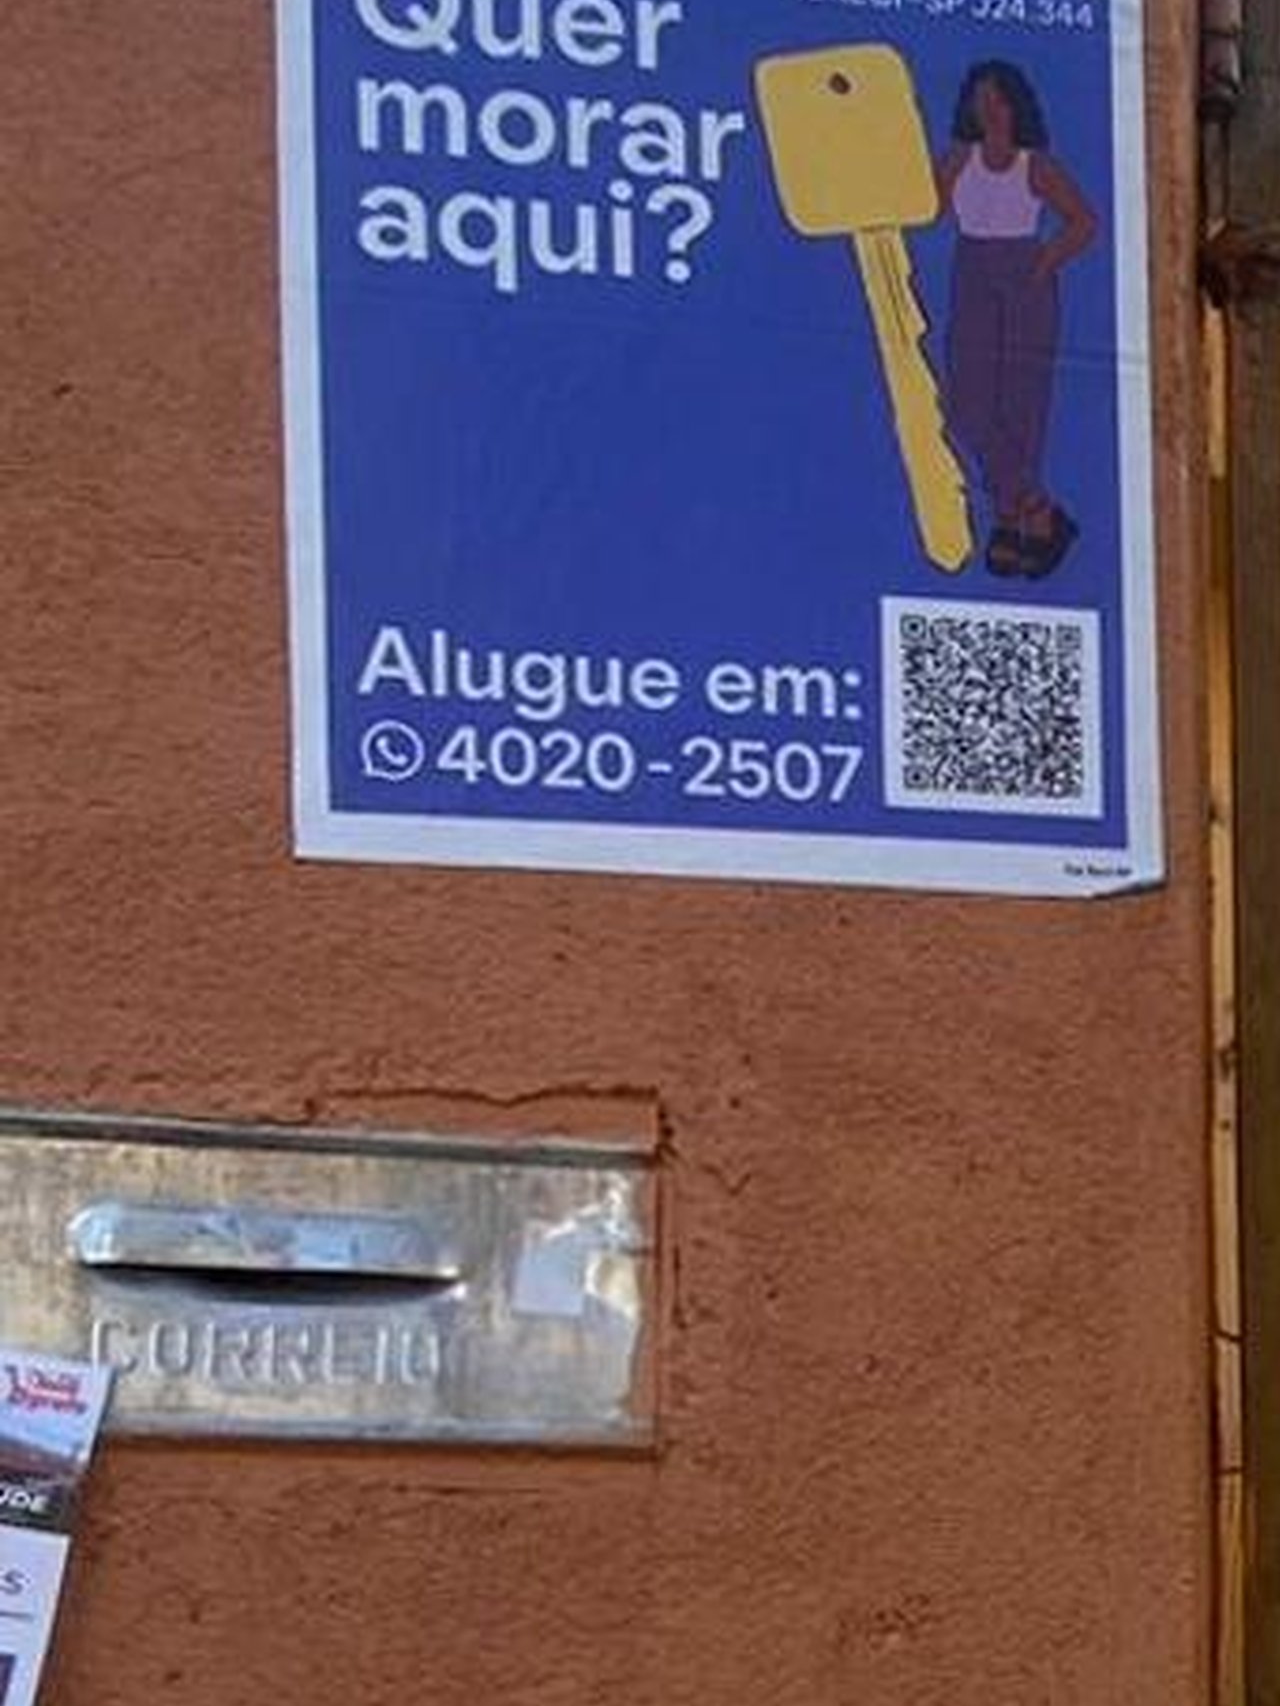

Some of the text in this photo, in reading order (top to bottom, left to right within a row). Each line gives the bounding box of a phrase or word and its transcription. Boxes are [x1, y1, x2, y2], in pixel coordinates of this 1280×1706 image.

[358, 72, 743, 180] morar
[358, 181, 713, 293] aqui?
[359, 627, 863, 721] Alugue em:
[436, 729, 863, 801] 4020-2507
[90, 1319, 439, 1386] CORREIO
